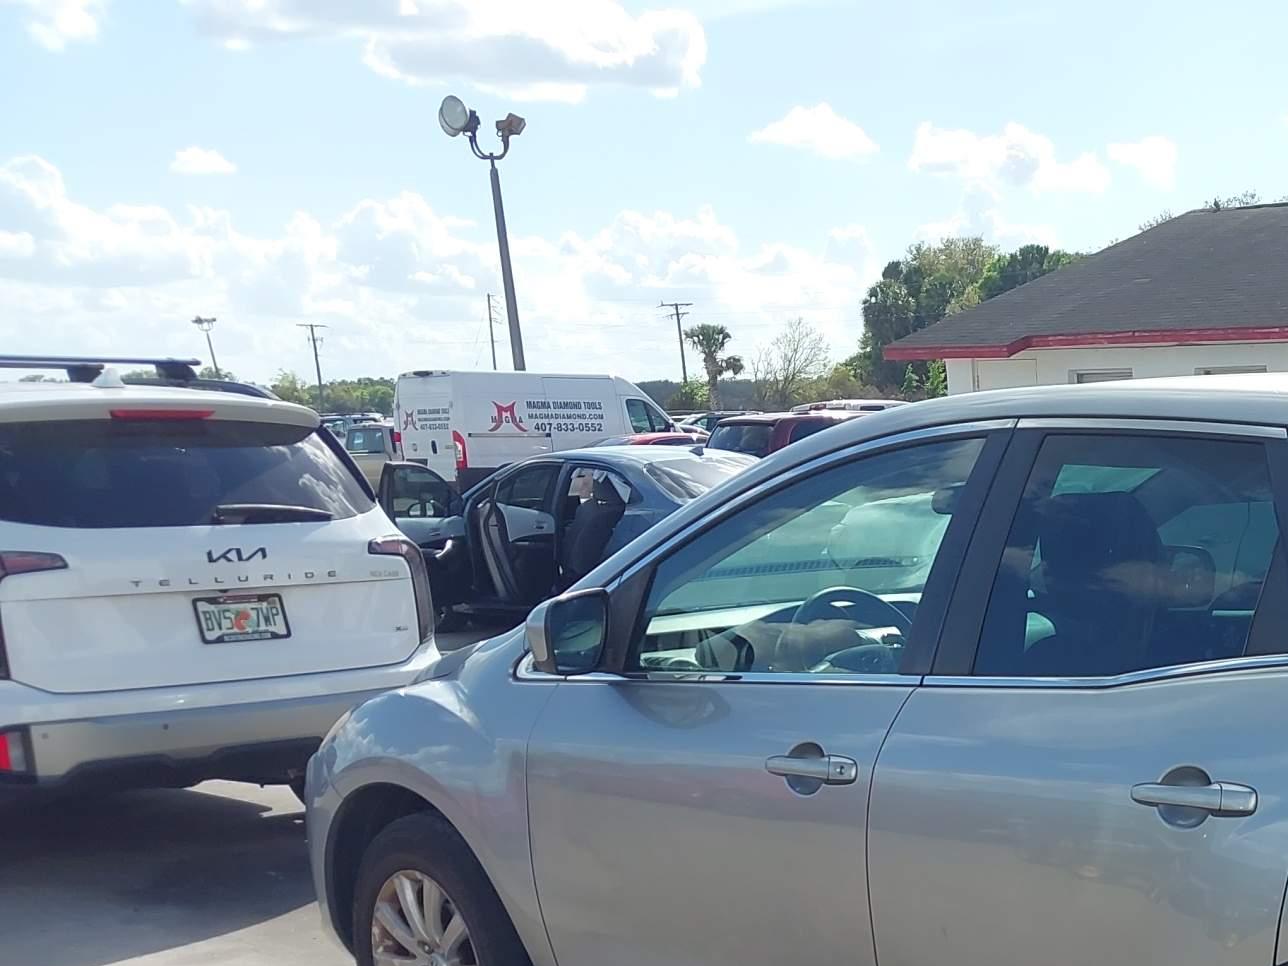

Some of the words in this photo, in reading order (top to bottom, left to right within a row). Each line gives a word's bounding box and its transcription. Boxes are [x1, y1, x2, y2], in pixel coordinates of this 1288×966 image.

[526, 401, 551, 410] MAGMA
[552, 401, 581, 410] DIAMOND
[583, 401, 603, 410] TOOLS
[534, 423, 603, 432] 407-833-0552
[206, 547, 268, 563] KIA
[130, 570, 337, 588] TELLURIDE
